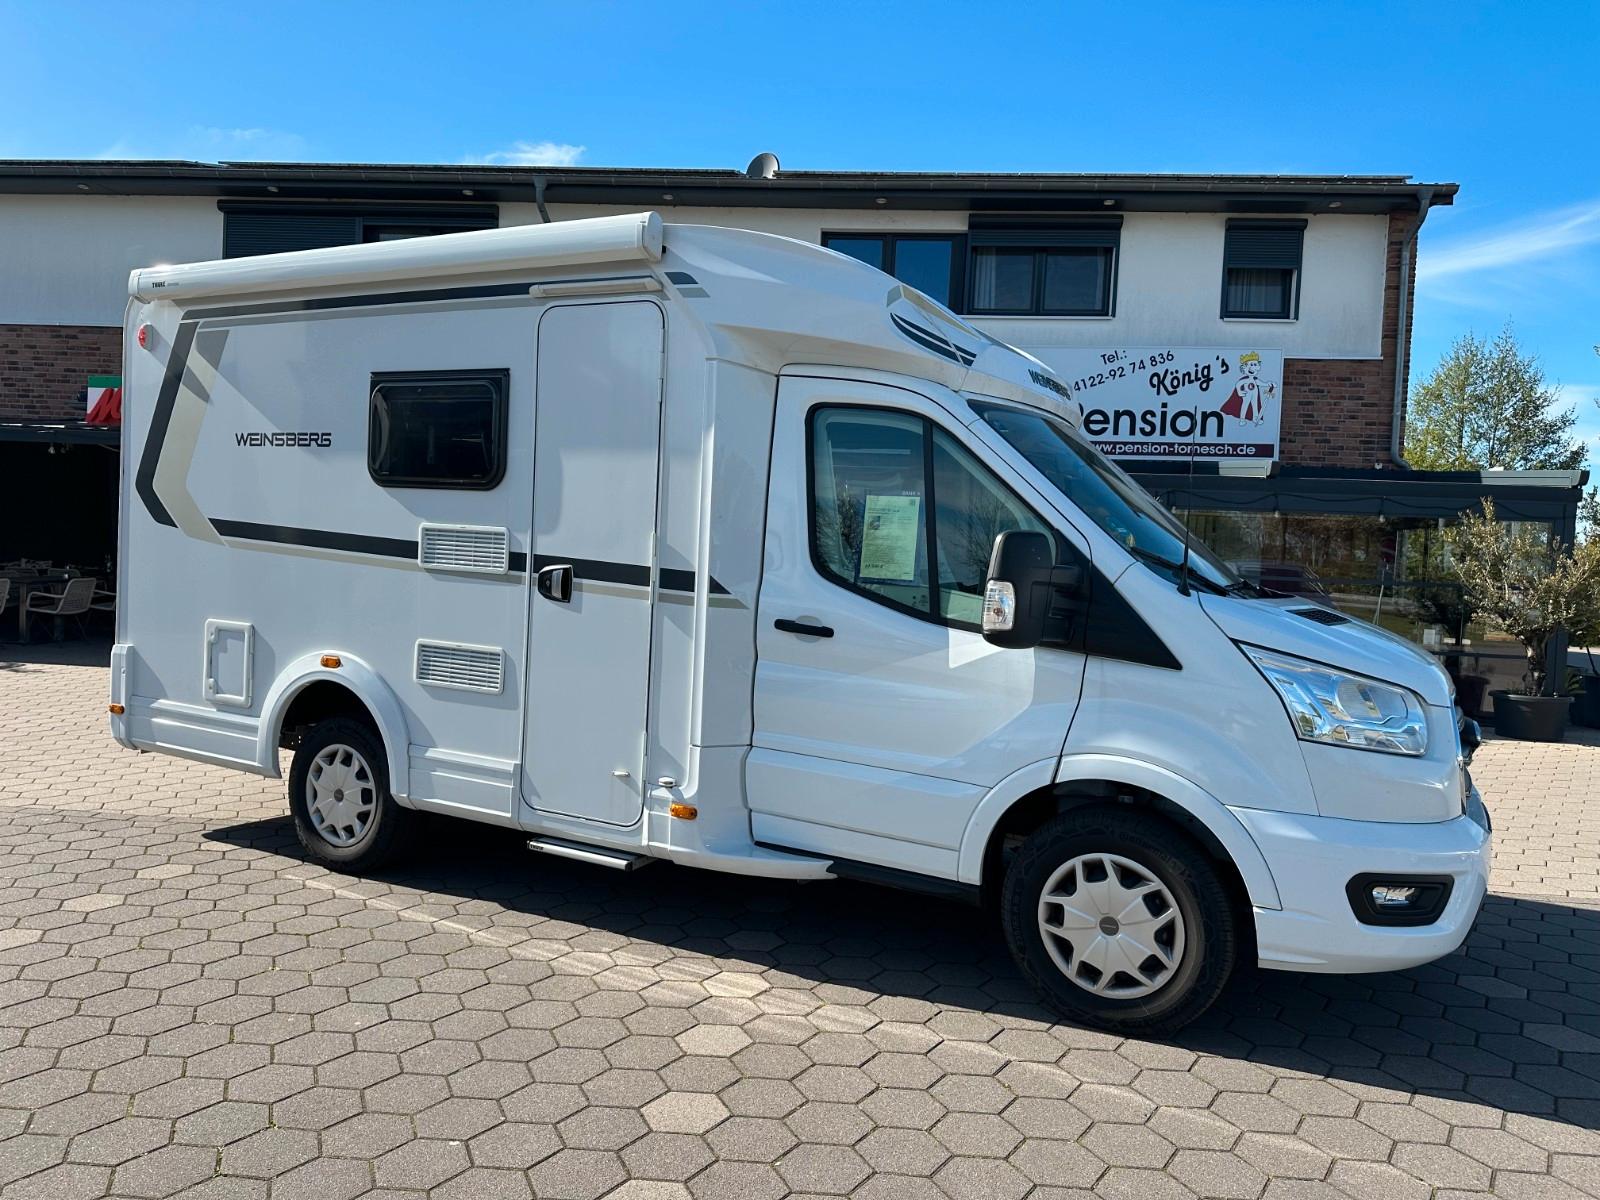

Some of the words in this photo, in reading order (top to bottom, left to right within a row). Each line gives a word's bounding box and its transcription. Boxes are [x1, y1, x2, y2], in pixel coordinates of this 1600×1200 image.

[1101, 350, 1128, 365] Tel.:
[1129, 359, 1147, 374] 74
[1150, 350, 1175, 367] 836
[235, 432, 332, 448] WEINSBERG
